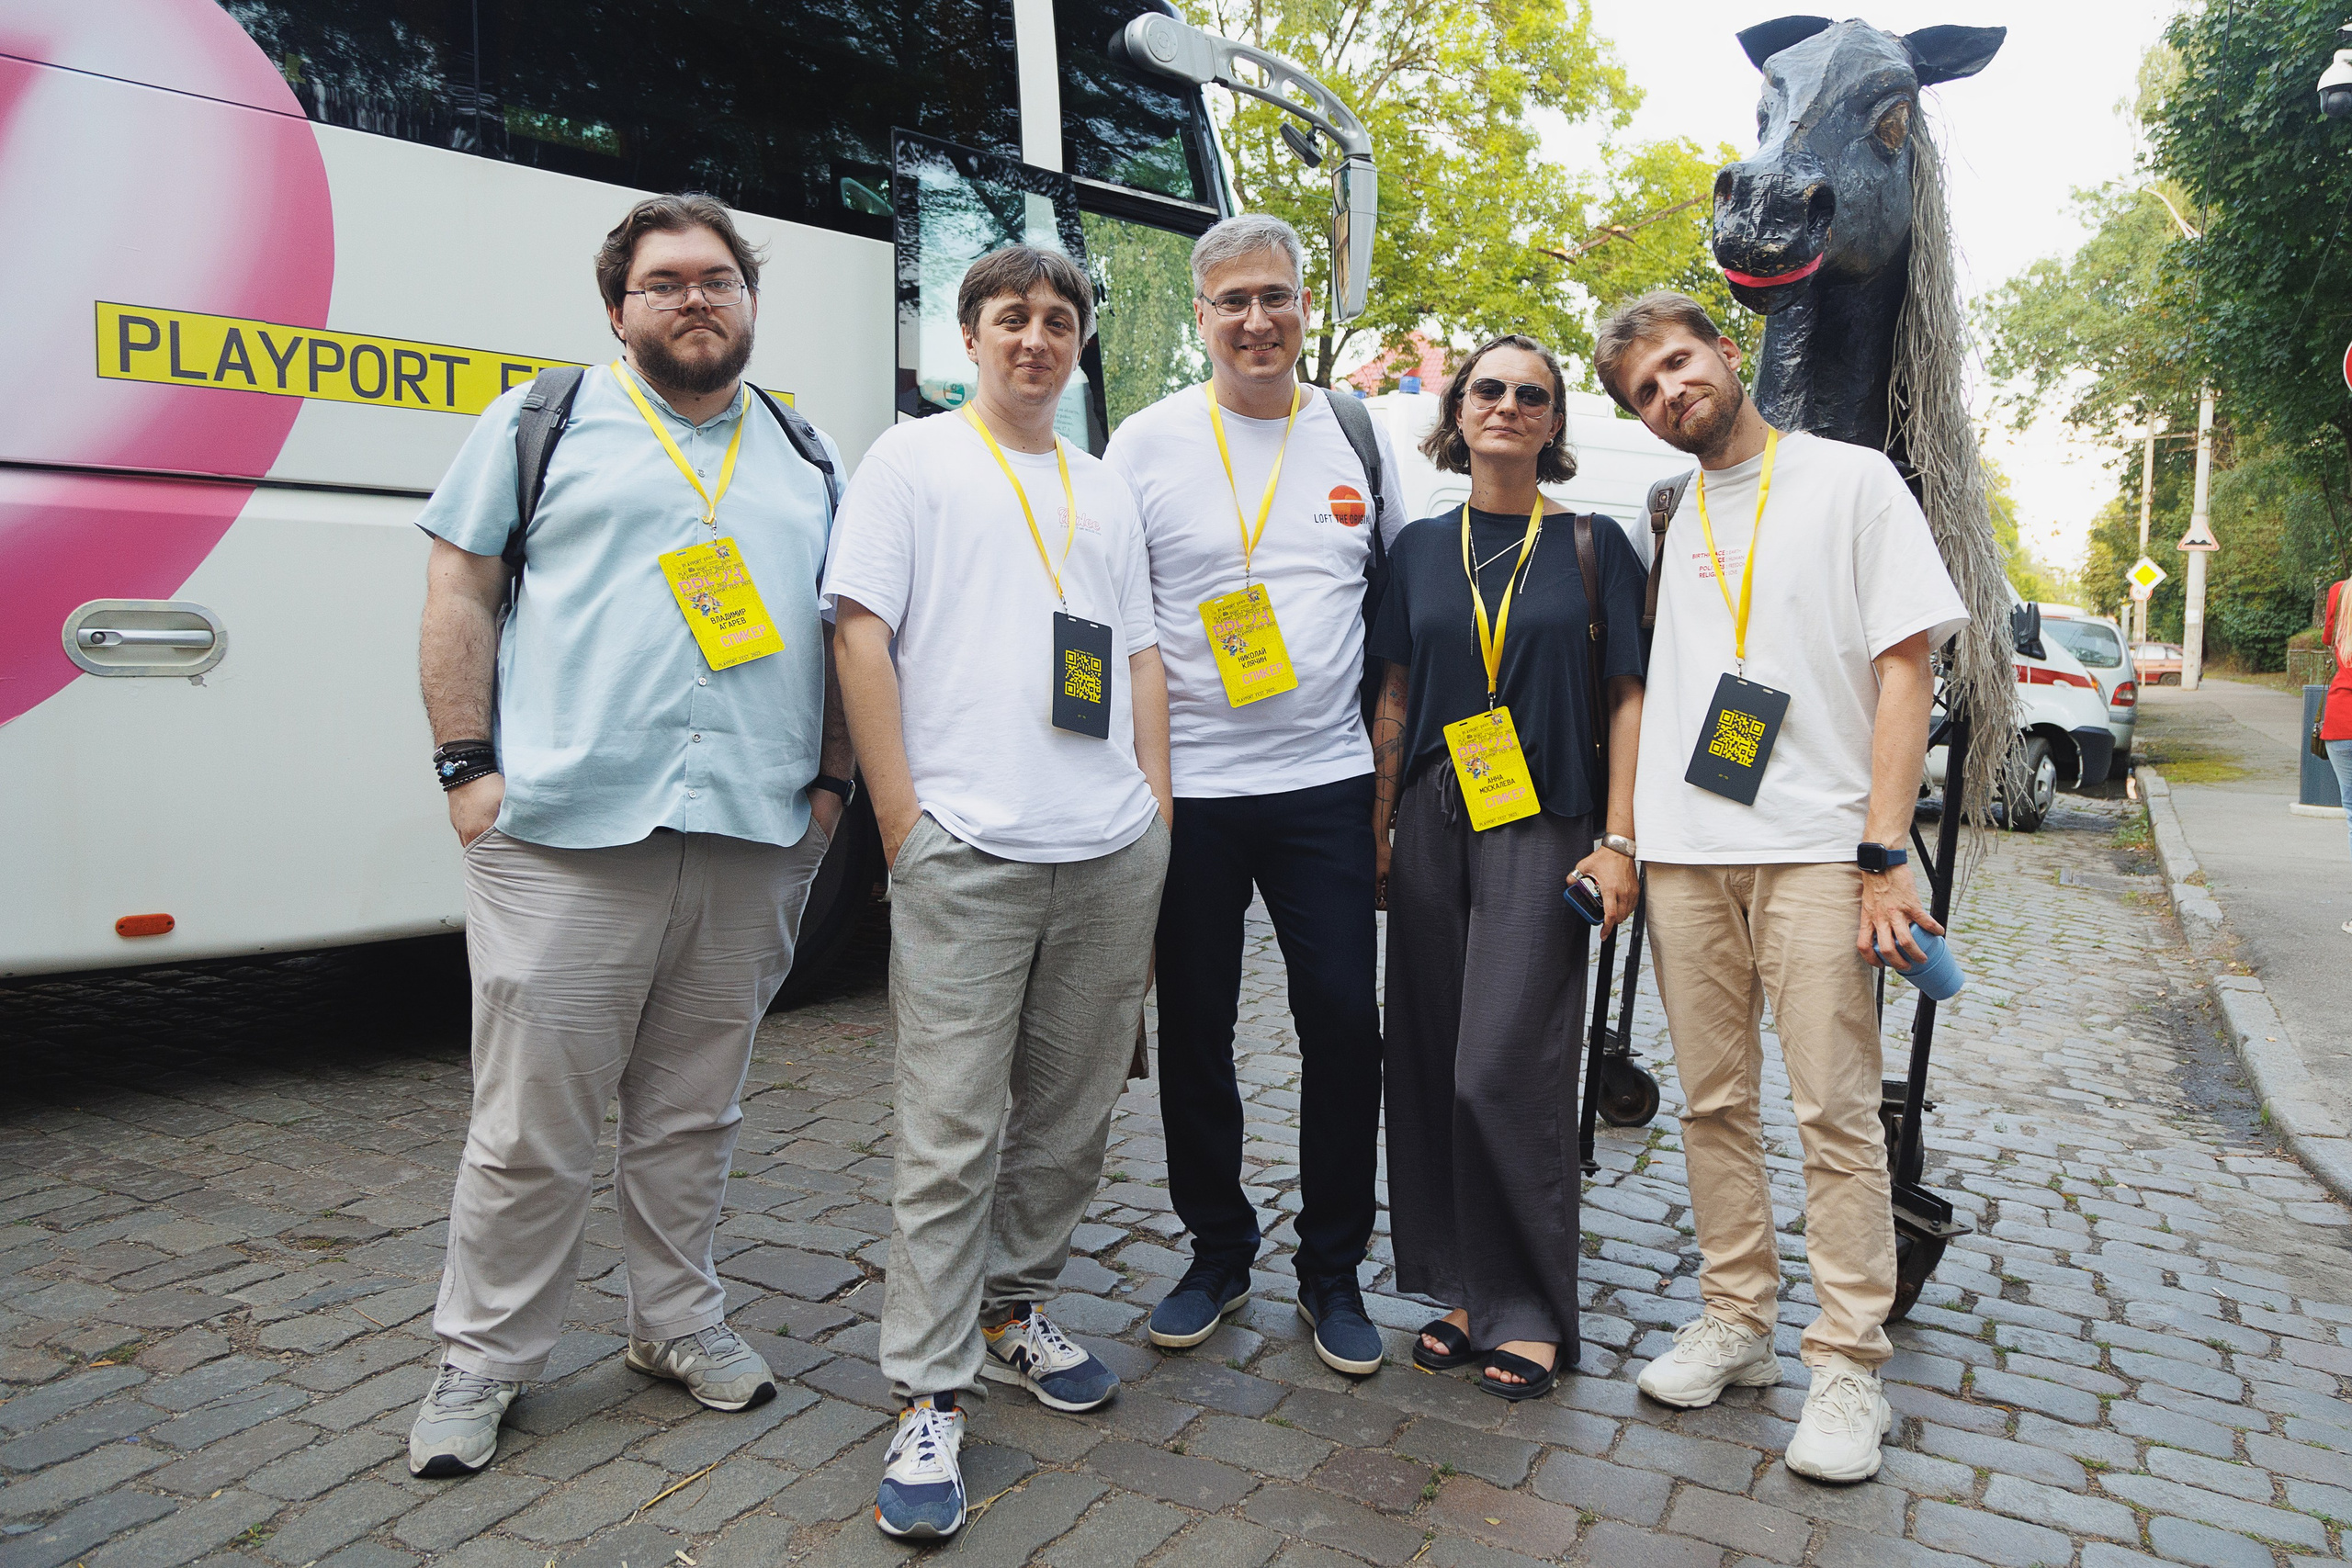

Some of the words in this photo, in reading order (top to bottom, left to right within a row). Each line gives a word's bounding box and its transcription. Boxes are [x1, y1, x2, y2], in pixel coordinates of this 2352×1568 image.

[119, 314, 470, 407] PLAYPORT
[1314, 513, 1332, 524] LOFT
[1335, 513, 1348, 525] THE
[710, 607, 746, 625] ВЛАДИМИР
[719, 616, 747, 630] АГАРЕВ
[720, 625, 766, 648] СПИКЕР
[1238, 647, 1267, 662] НИКОЛАЙ
[1241, 656, 1268, 669] КЛЯЧИН
[1242, 662, 1283, 684] СПИКЕР
[1479, 778, 1516, 794] МОСКАЛЕВА
[1487, 774, 1504, 784] АННА
[1485, 787, 1526, 808] СПИКЕР
